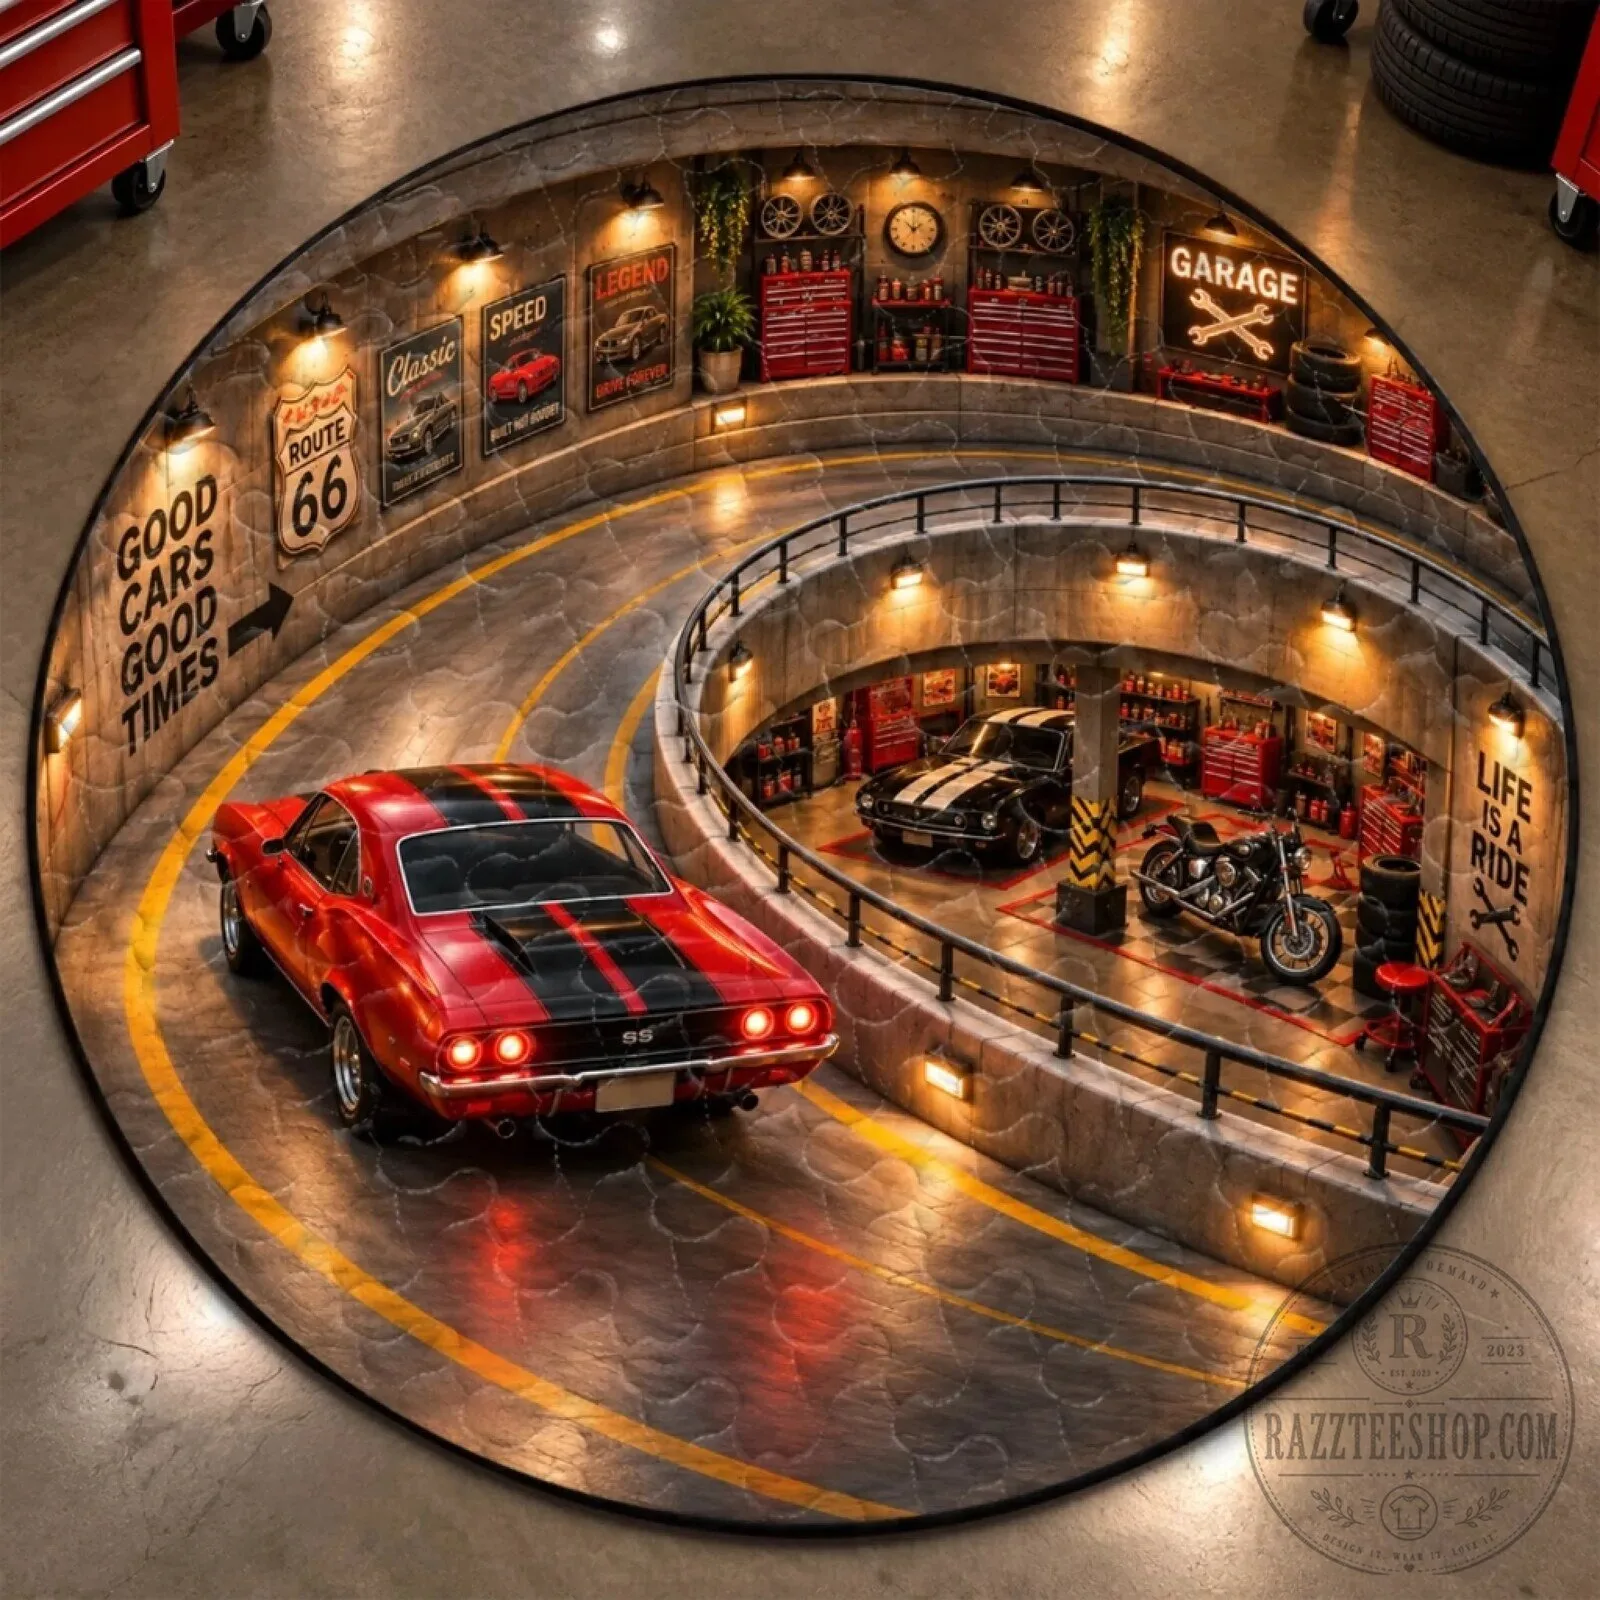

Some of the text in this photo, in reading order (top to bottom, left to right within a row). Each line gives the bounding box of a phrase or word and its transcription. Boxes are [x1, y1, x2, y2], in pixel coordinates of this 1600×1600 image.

[595, 255, 669, 300] LEGEND
[1170, 246, 1298, 306] GARAGE
[489, 295, 546, 341] SPEED
[387, 336, 456, 396] Classic
[289, 416, 345, 467] ROUTE
[116, 474, 218, 582] GOOD
[291, 453, 348, 538] 66
[119, 529, 214, 636] CARS
[120, 584, 218, 696] GOOD
[121, 636, 220, 757] TIMES
[1477, 750, 1532, 824] LIFE
[1482, 800, 1522, 855] IS A
[1470, 829, 1531, 907] RIDE
[622, 1028, 653, 1045] SS
